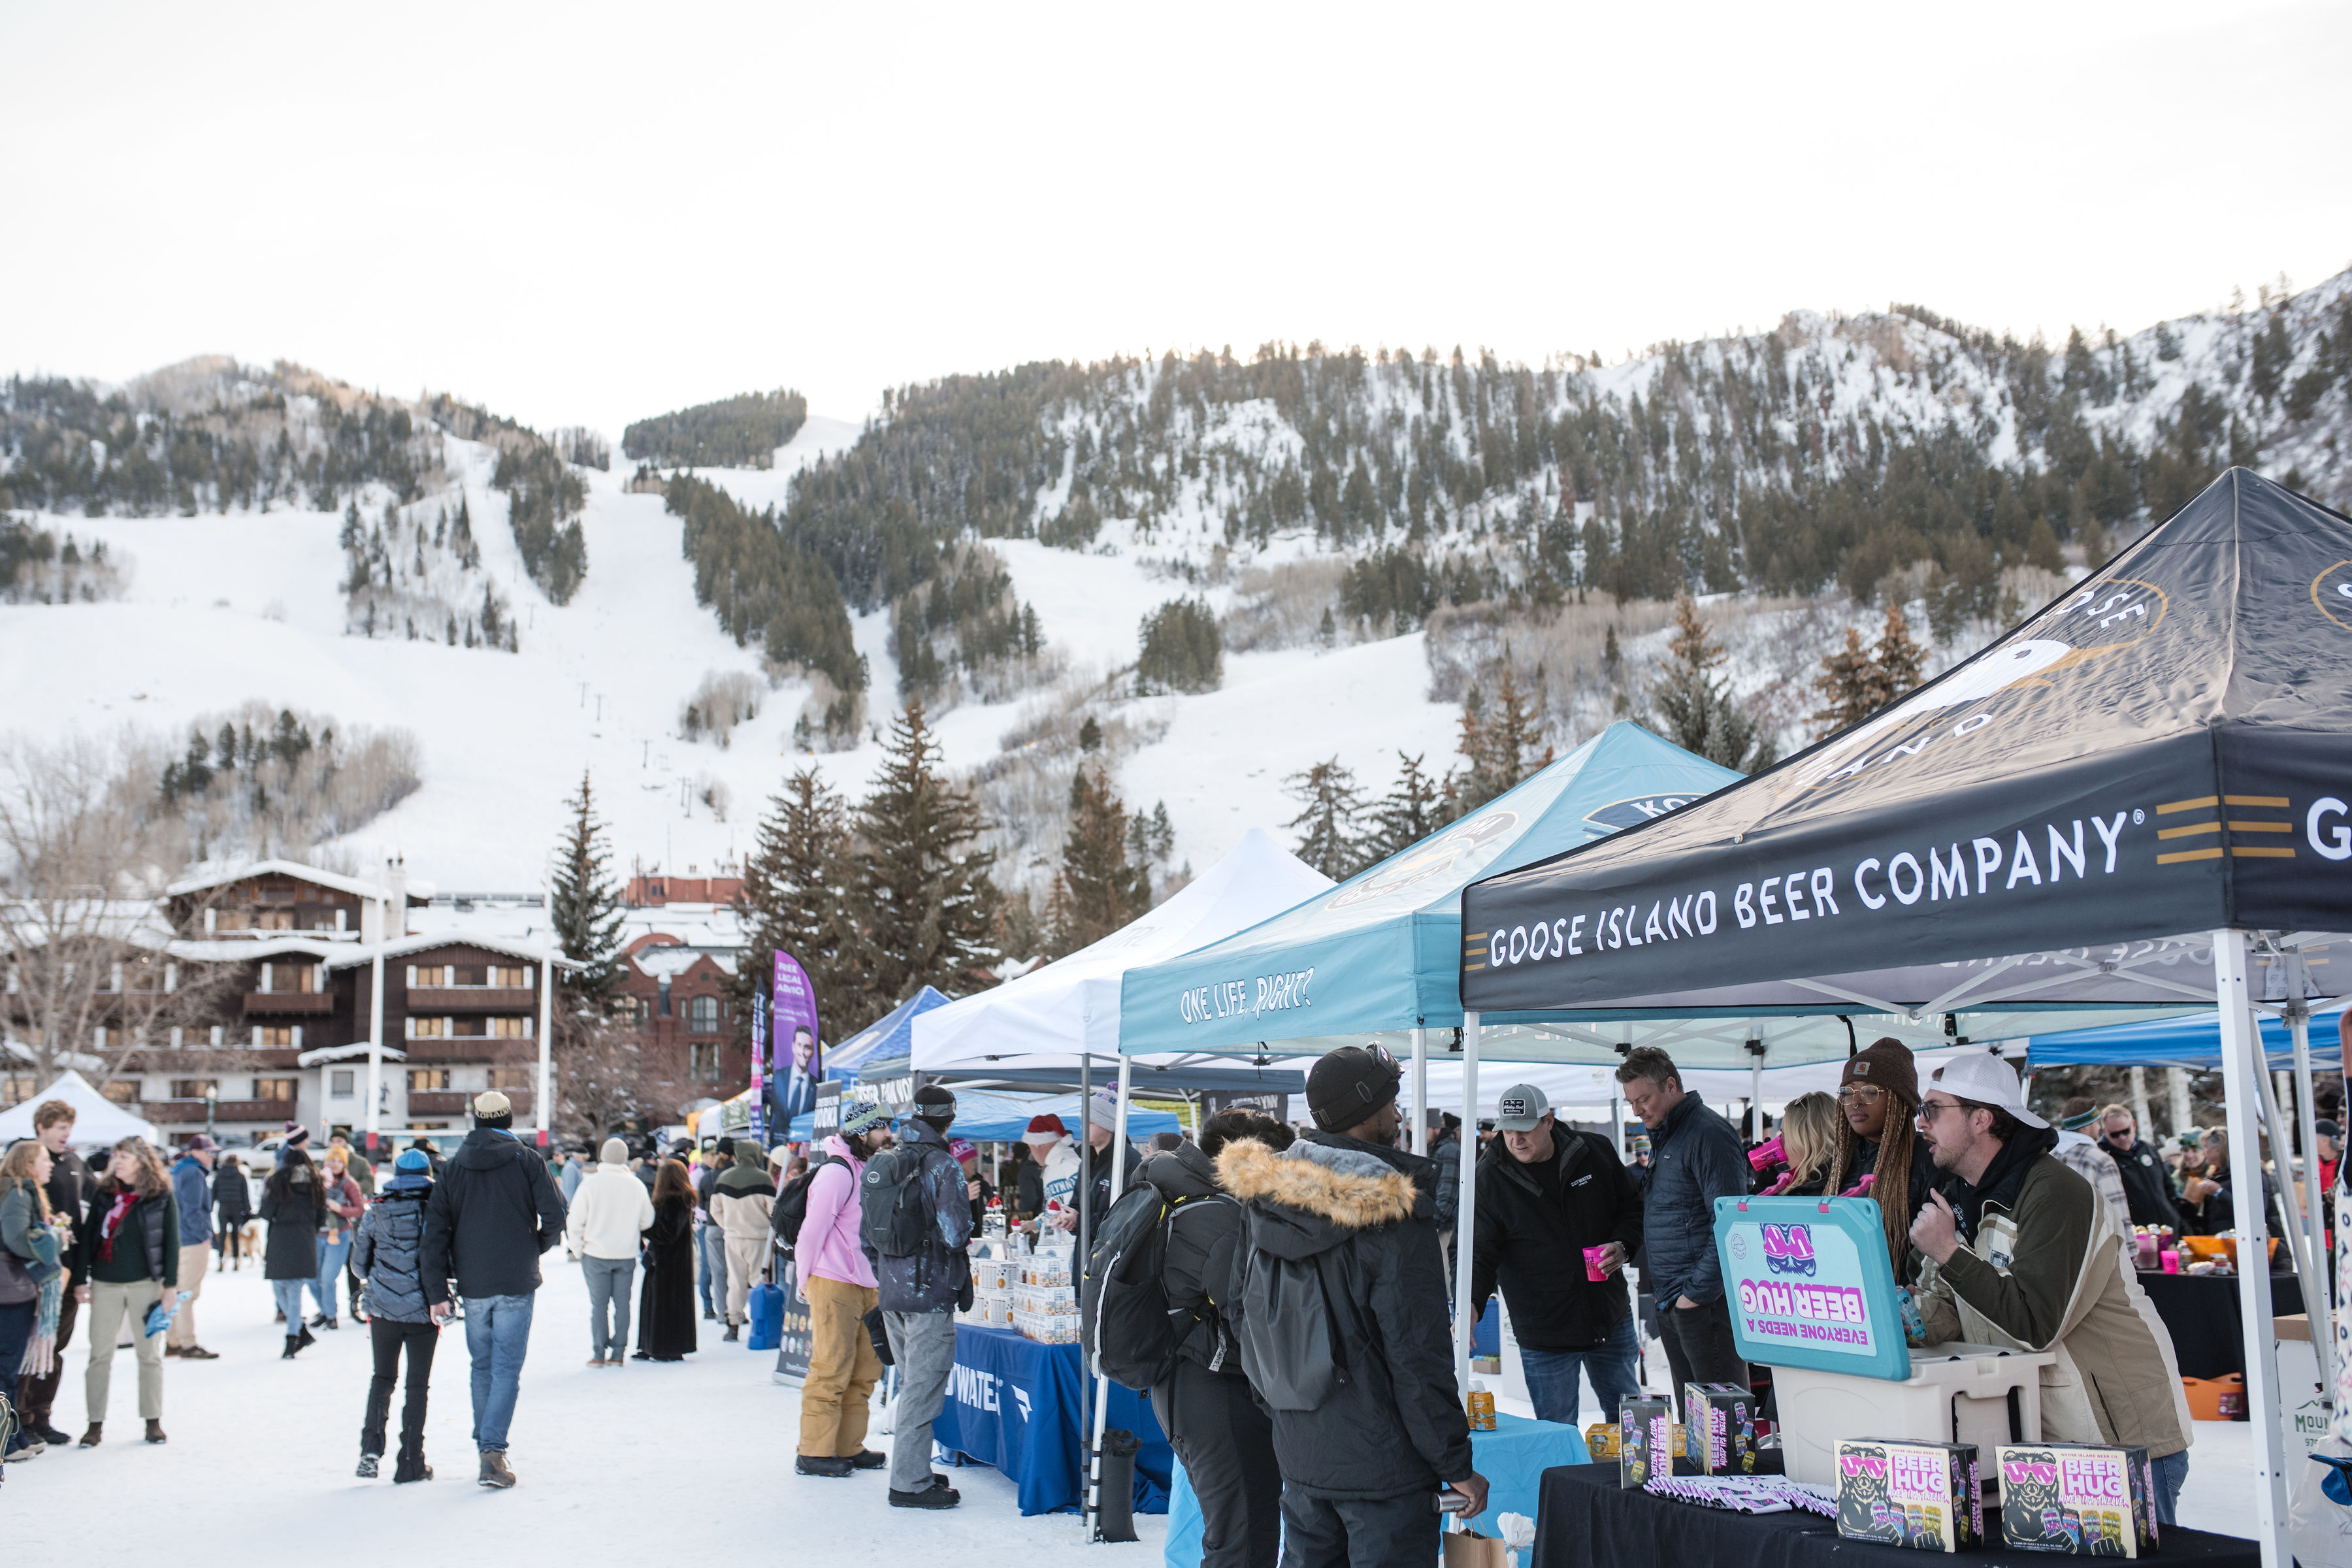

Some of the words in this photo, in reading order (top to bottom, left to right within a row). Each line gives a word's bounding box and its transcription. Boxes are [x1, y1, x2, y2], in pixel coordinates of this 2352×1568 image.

[1490, 915, 1586, 967] GOOSE
[1596, 890, 1717, 951] ISLAND
[1734, 867, 1840, 929] BEER
[1181, 986, 1212, 1024] ONE
[1252, 966, 1315, 1020] RIGHT?
[1740, 1279, 1794, 1316] HUG
[1793, 1282, 1865, 1324] BEER
[1746, 1318, 1755, 1333] A
[1758, 1320, 1797, 1336] NEEDS
[1800, 1323, 1869, 1345] EVERYONE
[1710, 1406, 1722, 1435] HUG
[1656, 1416, 1667, 1452] BEER
[1656, 1451, 1667, 1477] HUG
[1710, 1435, 1722, 1469] BEER
[1892, 1454, 1944, 1474] BEER
[1893, 1470, 1945, 1492] HUG
[2062, 1459, 2121, 1478] BEER
[2063, 1475, 2124, 1497] HUG
